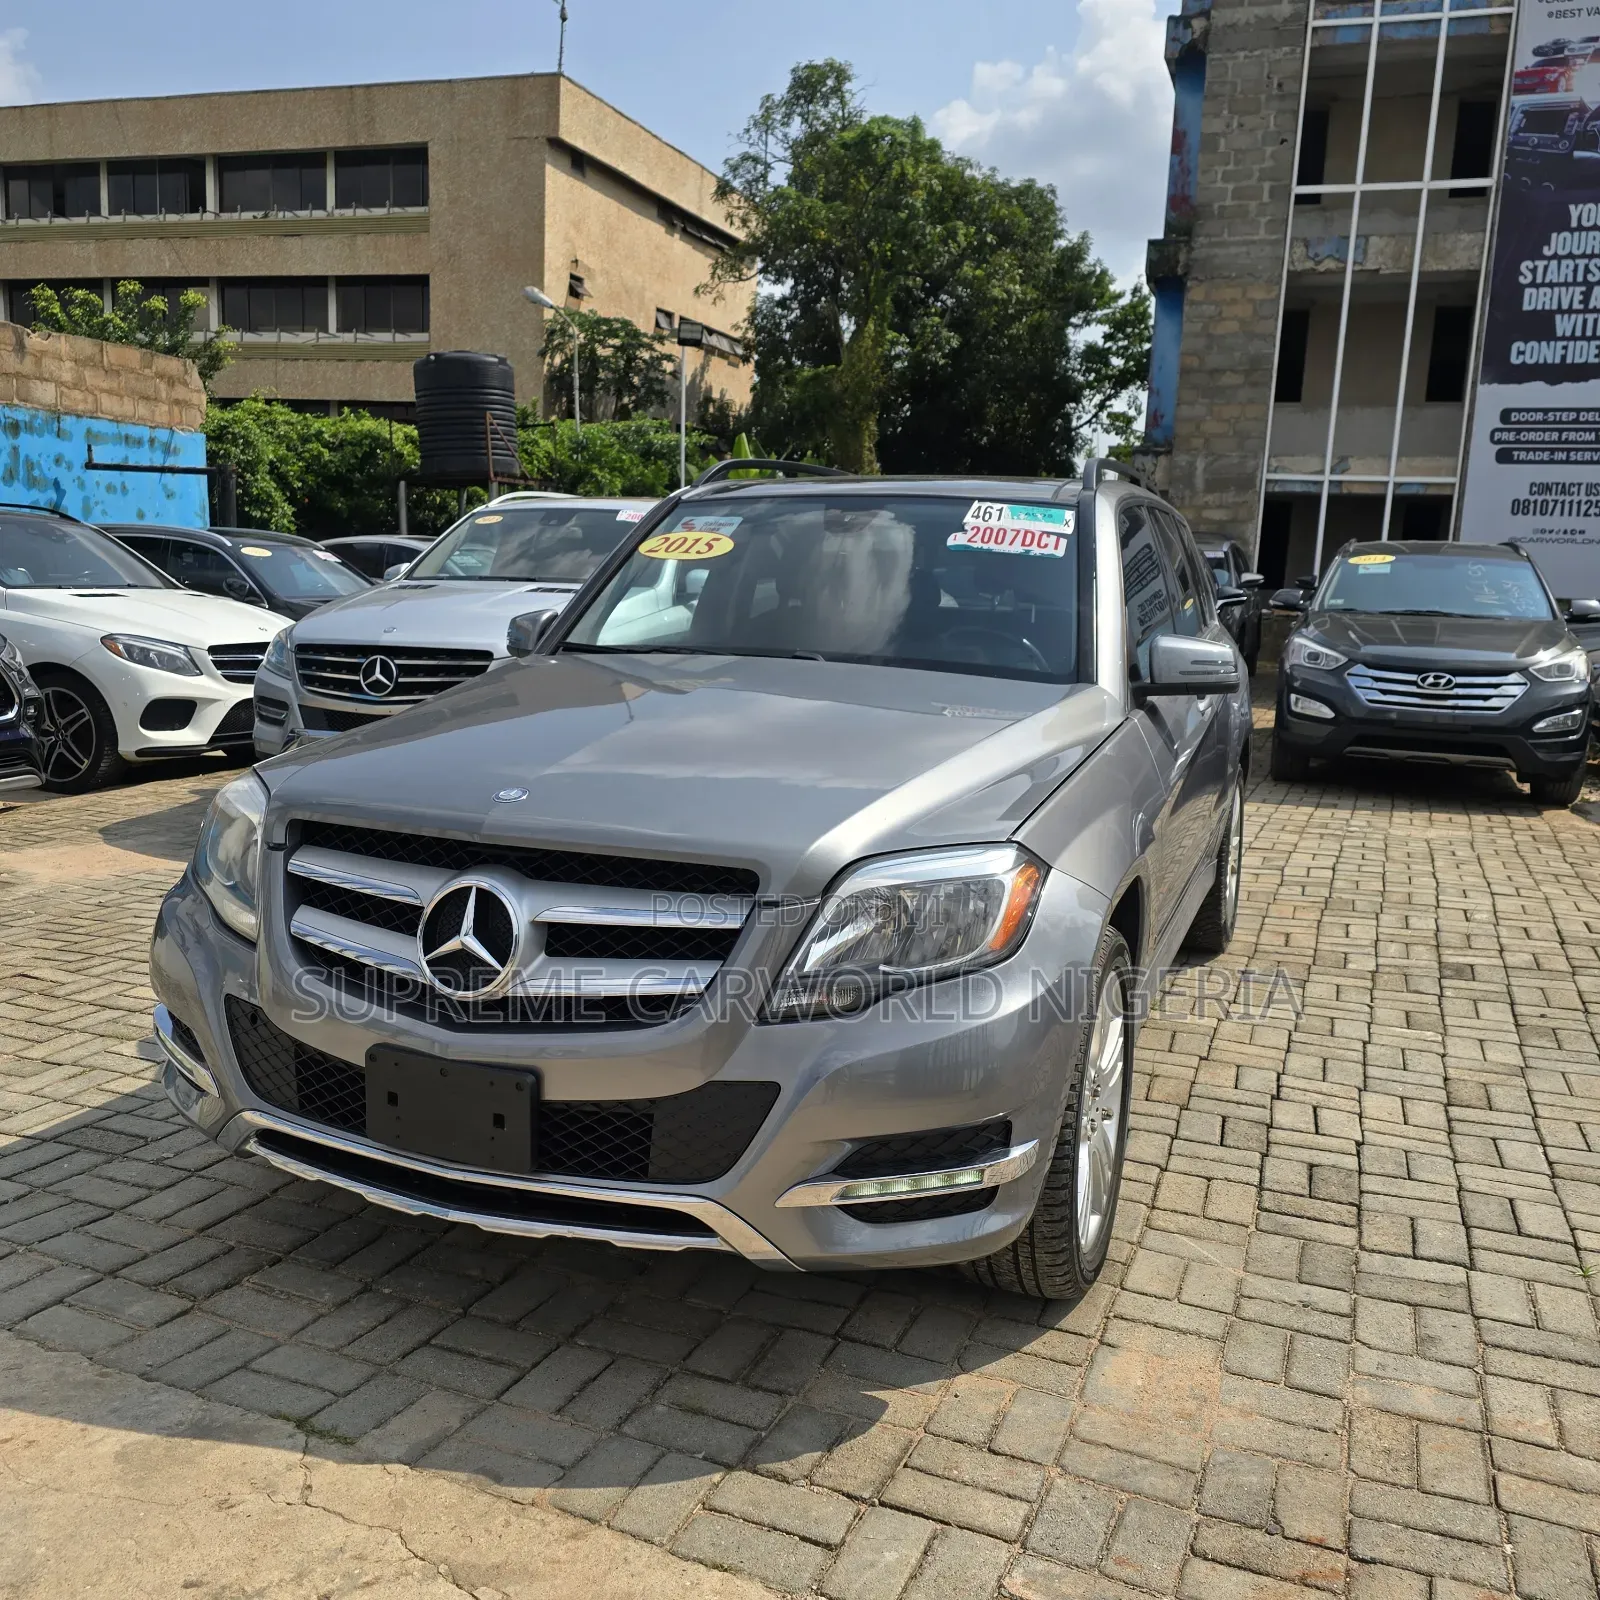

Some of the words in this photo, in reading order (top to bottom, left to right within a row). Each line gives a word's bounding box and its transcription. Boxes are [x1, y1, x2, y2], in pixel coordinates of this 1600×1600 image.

[1518, 258, 1600, 285] STARTS
[1522, 286, 1587, 311] DRIVE
[1510, 340, 1600, 365] CONFIDE
[1510, 411, 1577, 422] DOOR-STEP
[1494, 431, 1559, 442] PRE-ORDER
[1561, 431, 1596, 441] FROM
[1512, 451, 1567, 461] TRADE-IN
[1528, 482, 1583, 497] CONTACT
[971, 505, 1004, 523] 461
[1511, 498, 1600, 517] 0810711125
[644, 536, 722, 554] 2015
